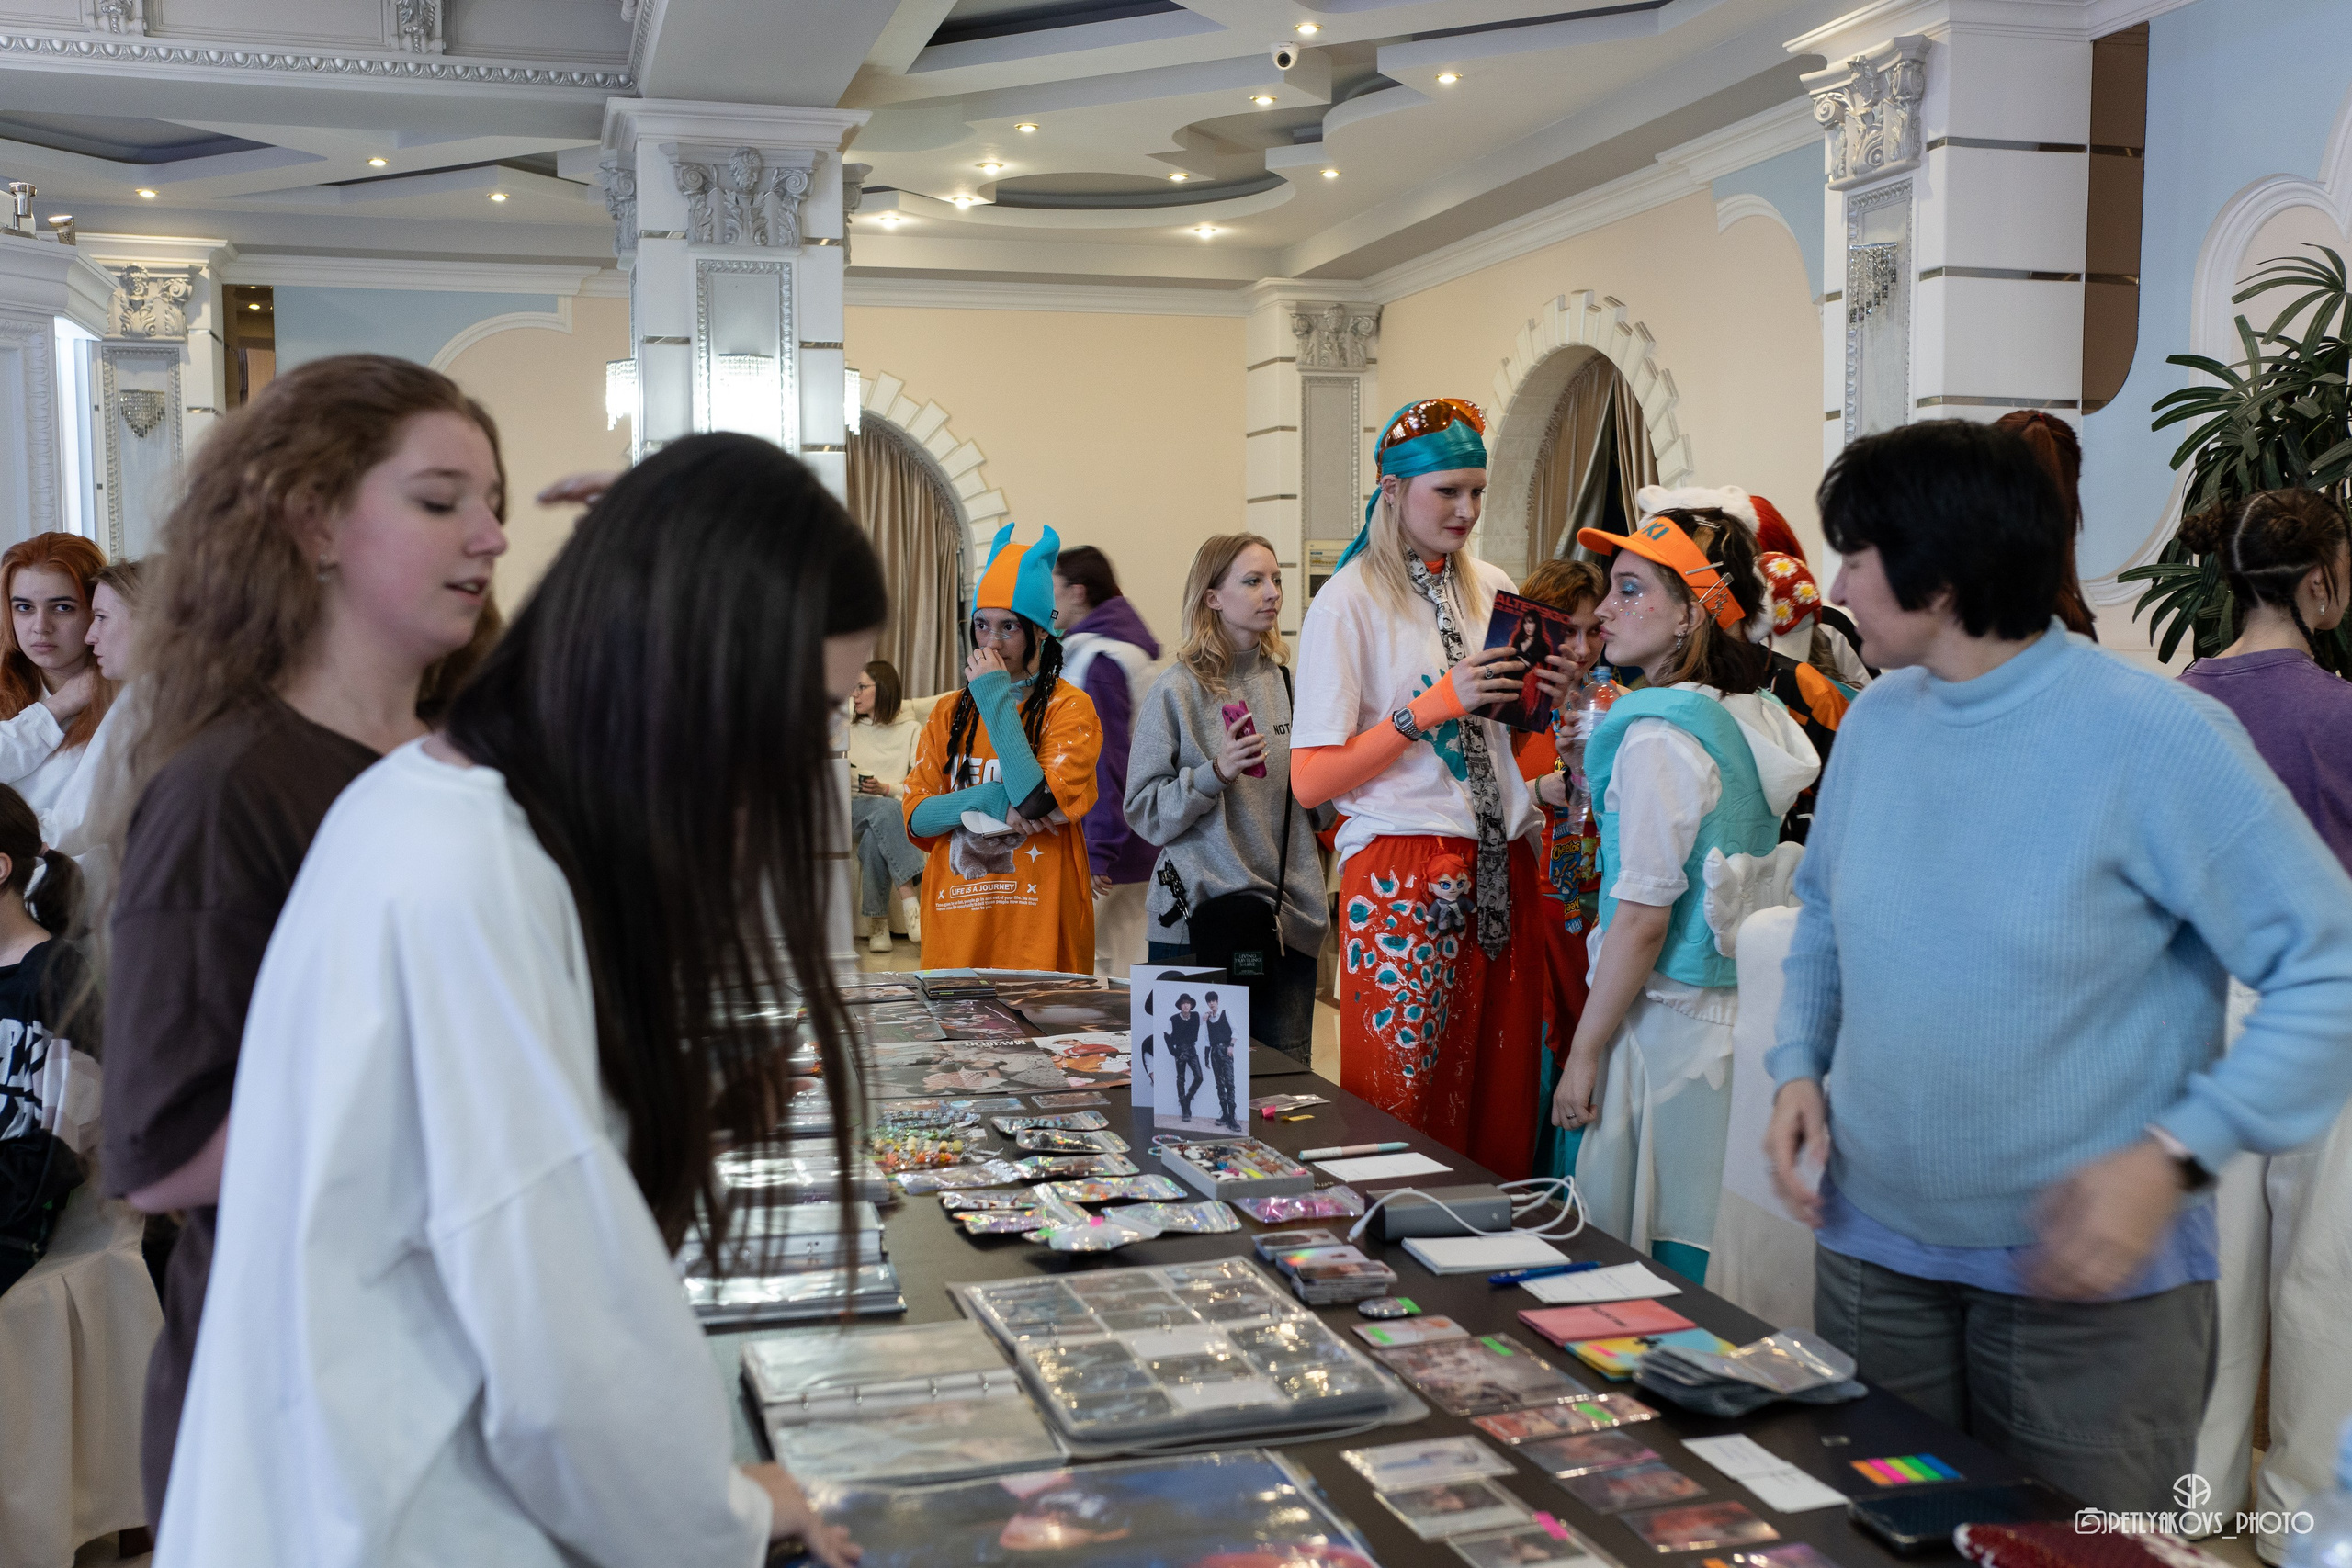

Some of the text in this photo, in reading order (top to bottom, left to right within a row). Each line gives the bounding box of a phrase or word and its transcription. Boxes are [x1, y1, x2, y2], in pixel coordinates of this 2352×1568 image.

[1273, 723, 1290, 735] NOT
[1552, 840, 1581, 861] Cheetos
[951, 887, 965, 896] LIFE
[978, 883, 1015, 892] JOURNEY
